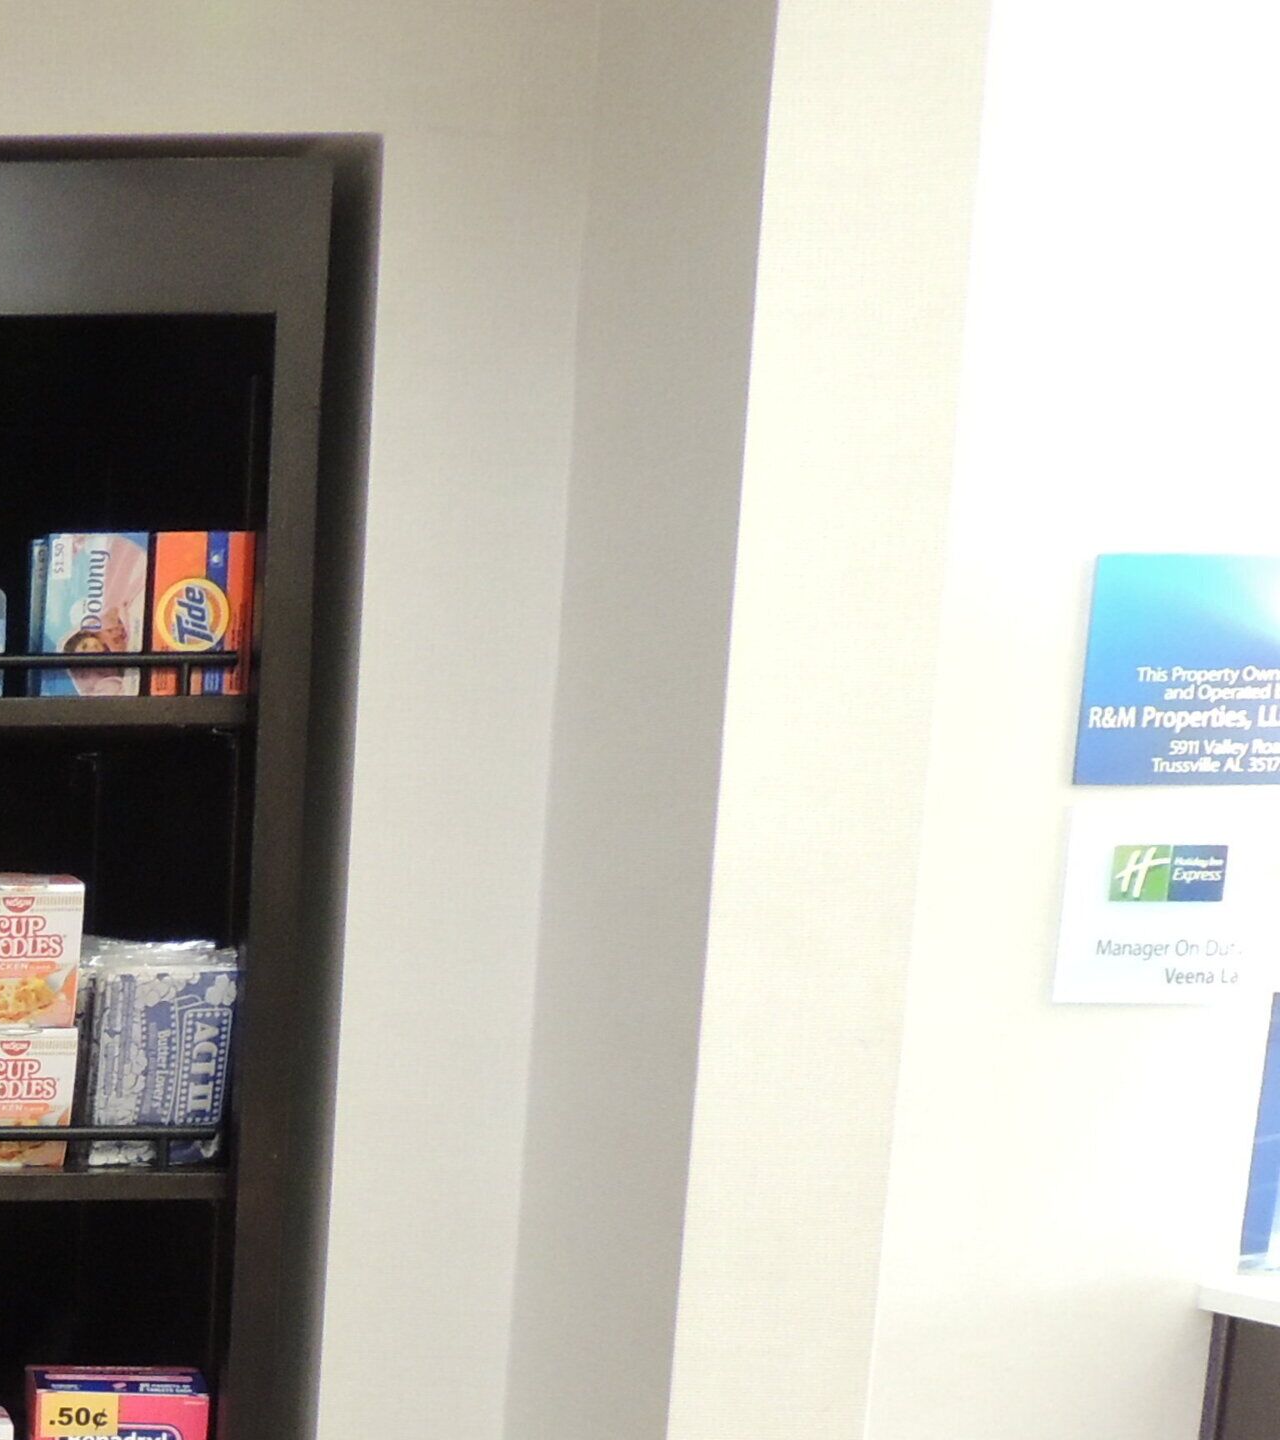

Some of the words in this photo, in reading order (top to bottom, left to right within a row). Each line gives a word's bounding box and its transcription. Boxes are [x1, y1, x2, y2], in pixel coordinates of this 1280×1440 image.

[81, 550, 111, 631] Downy
[175, 586, 214, 645] Tide
[1137, 666, 1168, 682] This
[1171, 666, 1240, 685] Property
[1164, 684, 1195, 700] and
[1198, 684, 1271, 703] Operated
[1088, 706, 1136, 729] R&M
[1141, 705, 1252, 733] Properties,
[1257, 705, 1280, 727] LL
[1169, 740, 1200, 755] 5911
[1203, 739, 1249, 758] Valley
[1151, 757, 1220, 773] Trussville
[1223, 757, 1244, 772] AL
[1172, 867, 1222, 884] Express
[1096, 939, 1170, 960] Manager
[1175, 939, 1199, 957] On
[1164, 968, 1215, 984] Veena
[191, 1021, 220, 1076] ACT
[49, 1408, 108, 1429] .50¢
